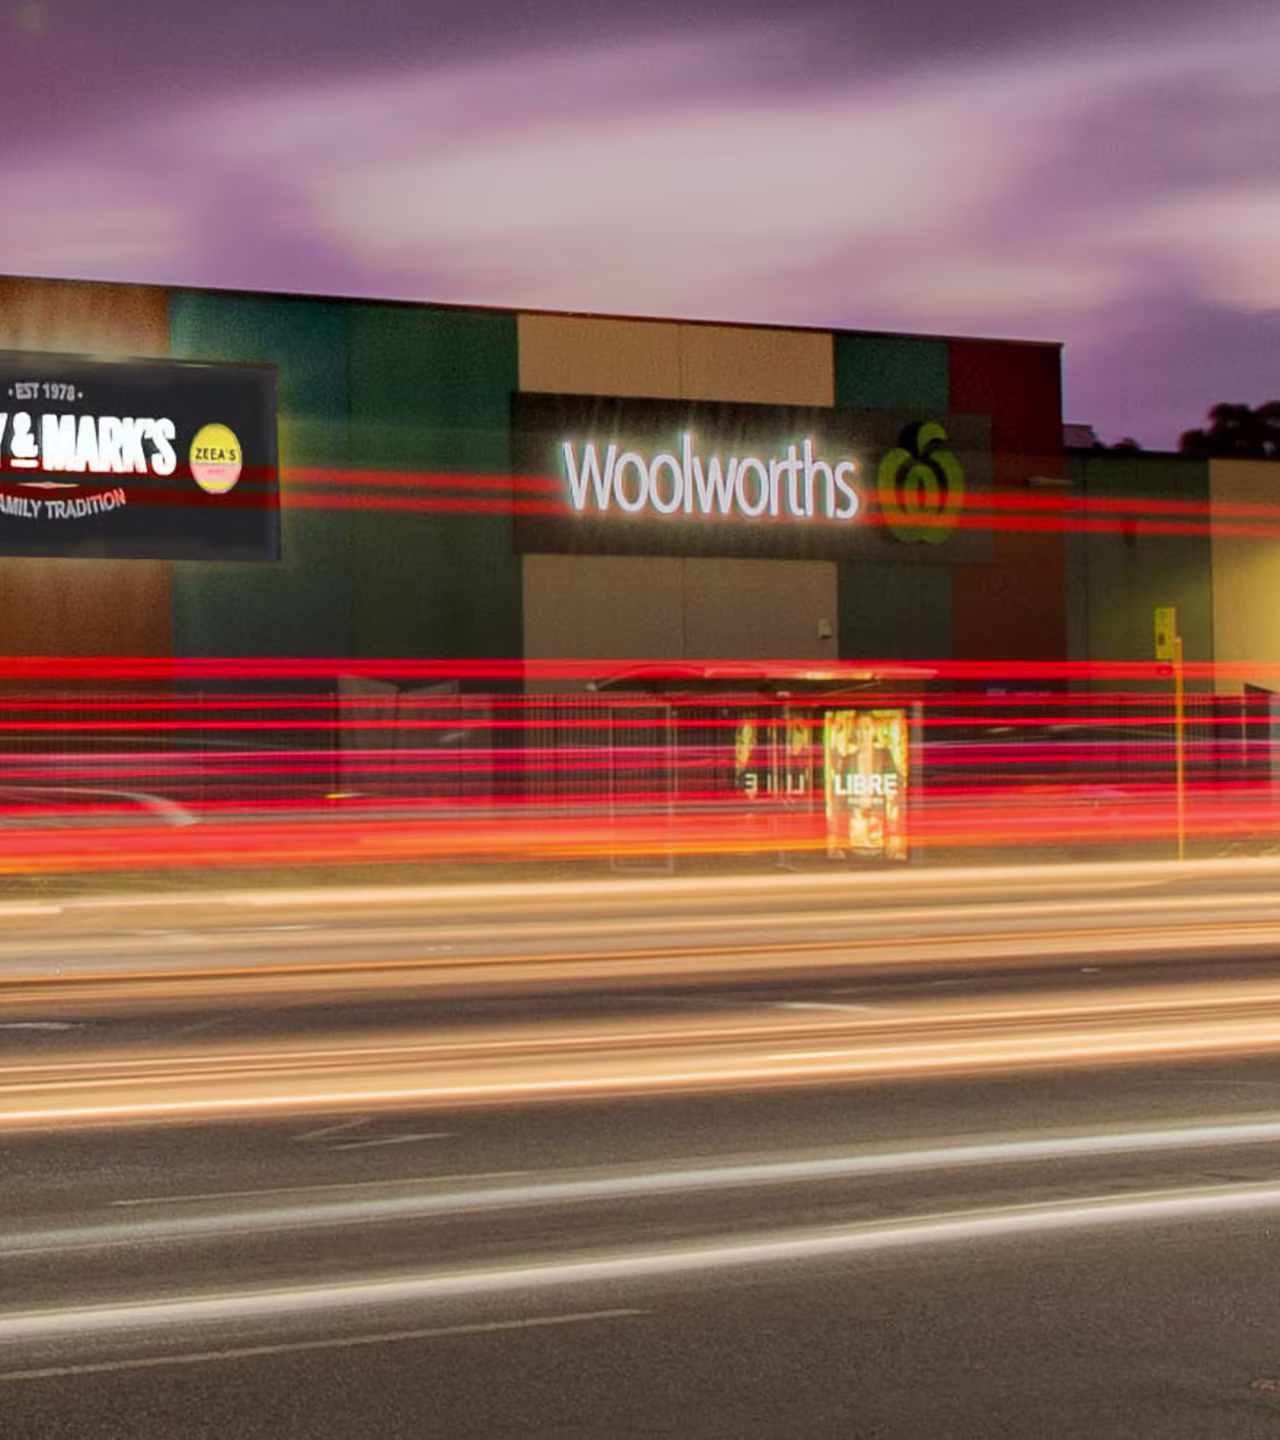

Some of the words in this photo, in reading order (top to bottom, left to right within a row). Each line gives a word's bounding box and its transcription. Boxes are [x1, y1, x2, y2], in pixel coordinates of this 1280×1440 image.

[15, 382, 40, 400] EST
[42, 382, 76, 402] 1978
[10, 411, 39, 468] &
[41, 413, 177, 476] MARK'S
[195, 447, 237, 461] ZEEA'S
[560, 432, 861, 520] Woolworths
[44, 487, 127, 519] TRADITION
[834, 772, 898, 796] LIBRE
